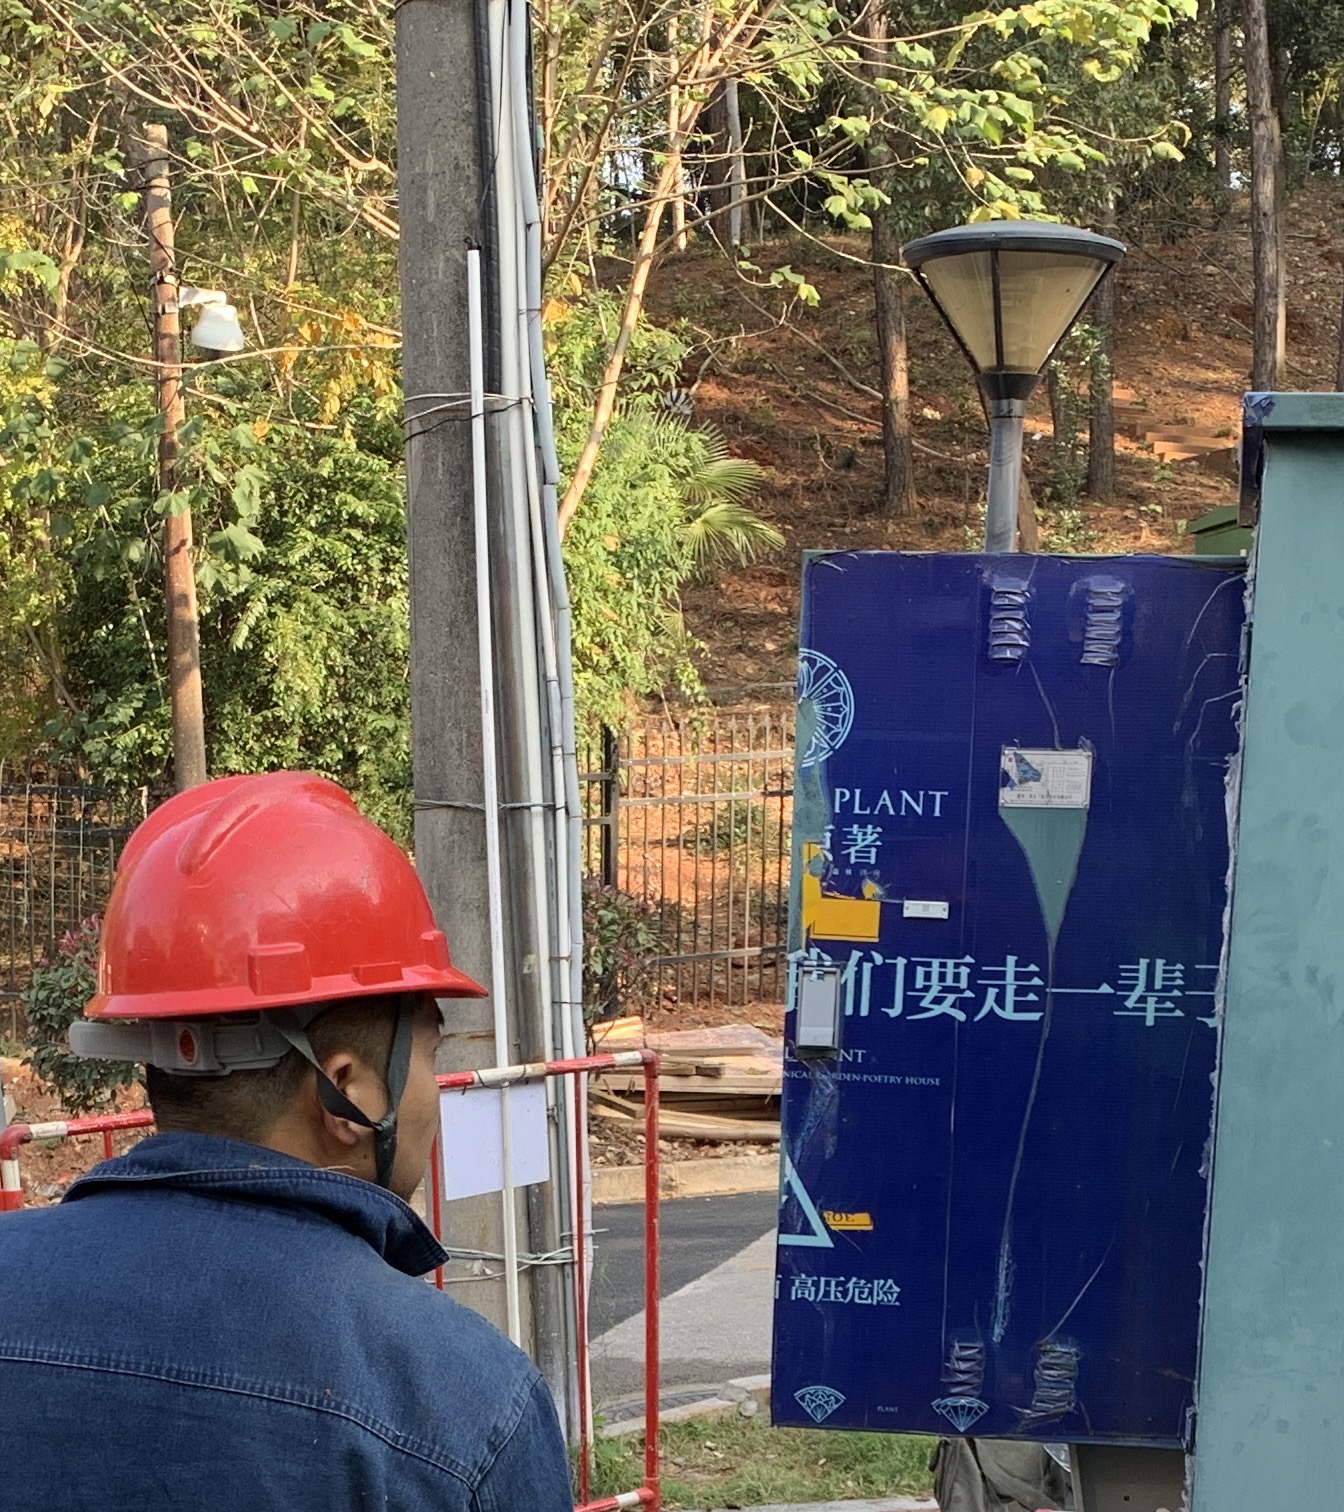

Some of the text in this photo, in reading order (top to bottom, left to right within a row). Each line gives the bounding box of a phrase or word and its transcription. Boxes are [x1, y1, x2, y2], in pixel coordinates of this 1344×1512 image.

[834, 788, 949, 817] PLANT
[906, 1076, 940, 1086] HOUSE
[790, 1273, 901, 1306] 高压危险
